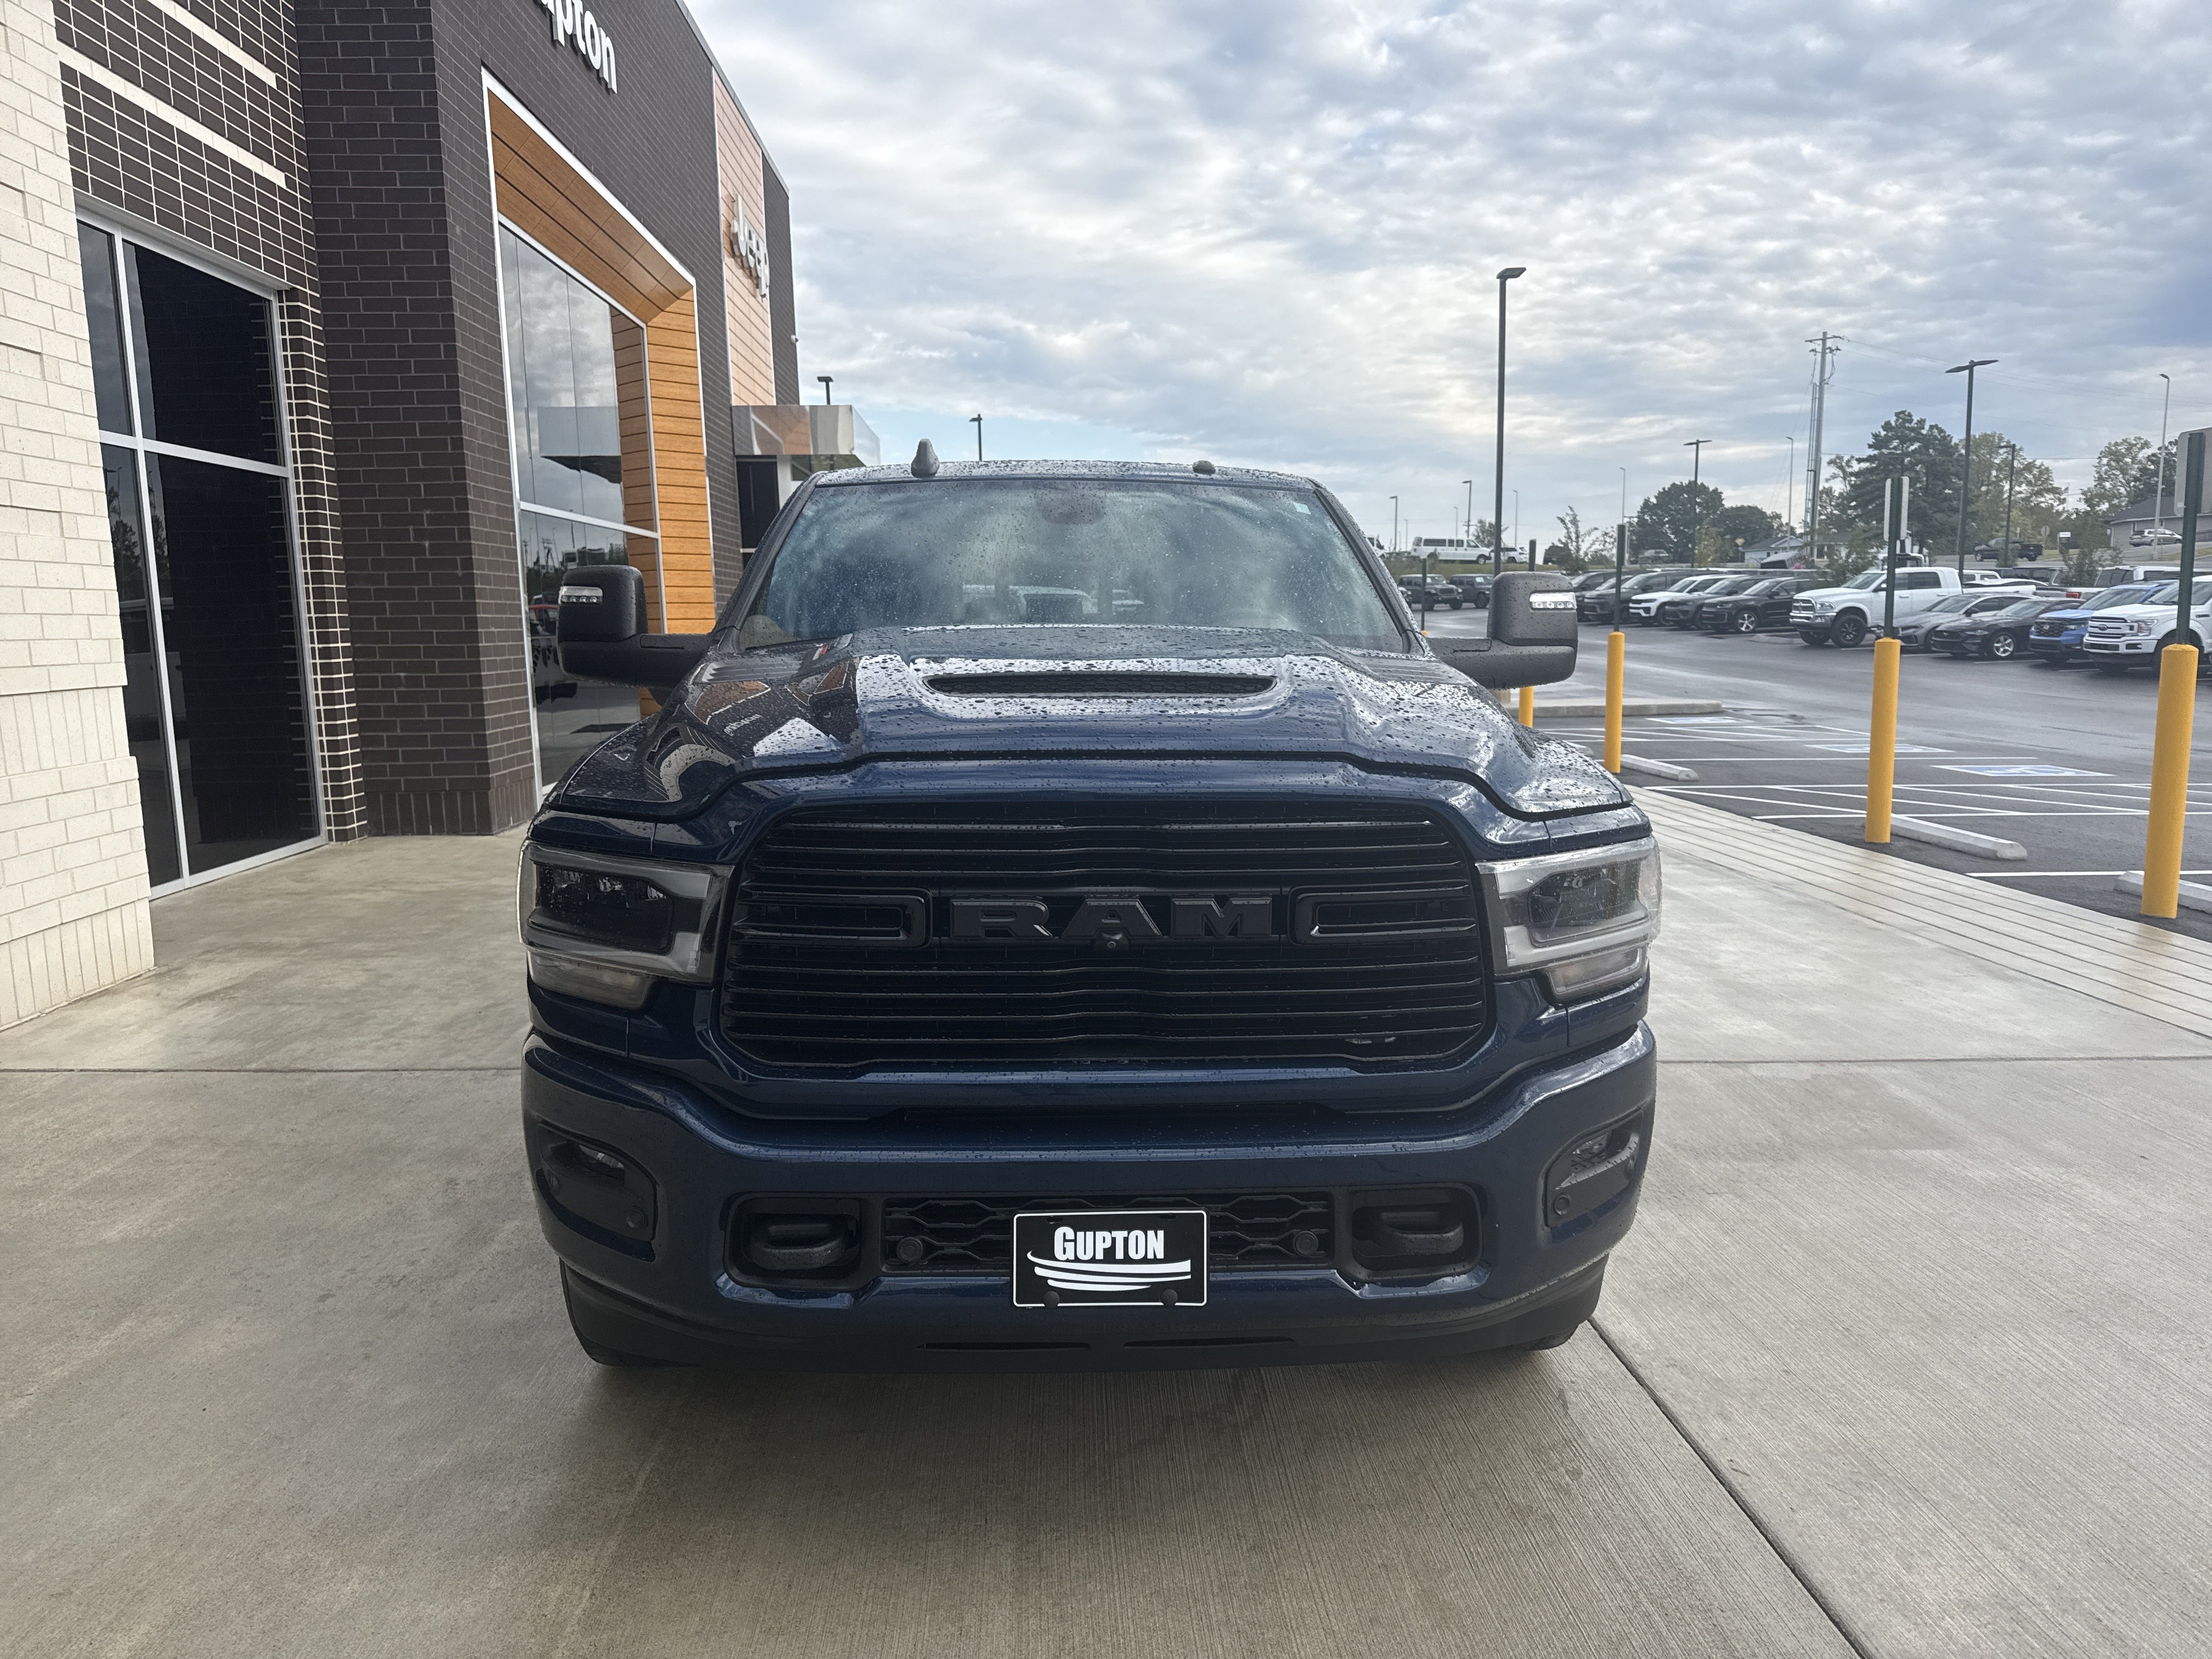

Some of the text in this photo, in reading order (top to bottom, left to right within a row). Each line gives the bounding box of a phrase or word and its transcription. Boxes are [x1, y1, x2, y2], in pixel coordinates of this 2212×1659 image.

[541, 0, 617, 94] pton
[731, 194, 770, 296] Jeep
[950, 896, 1272, 939] RAM
[1054, 1226, 1164, 1260] GUPTON
